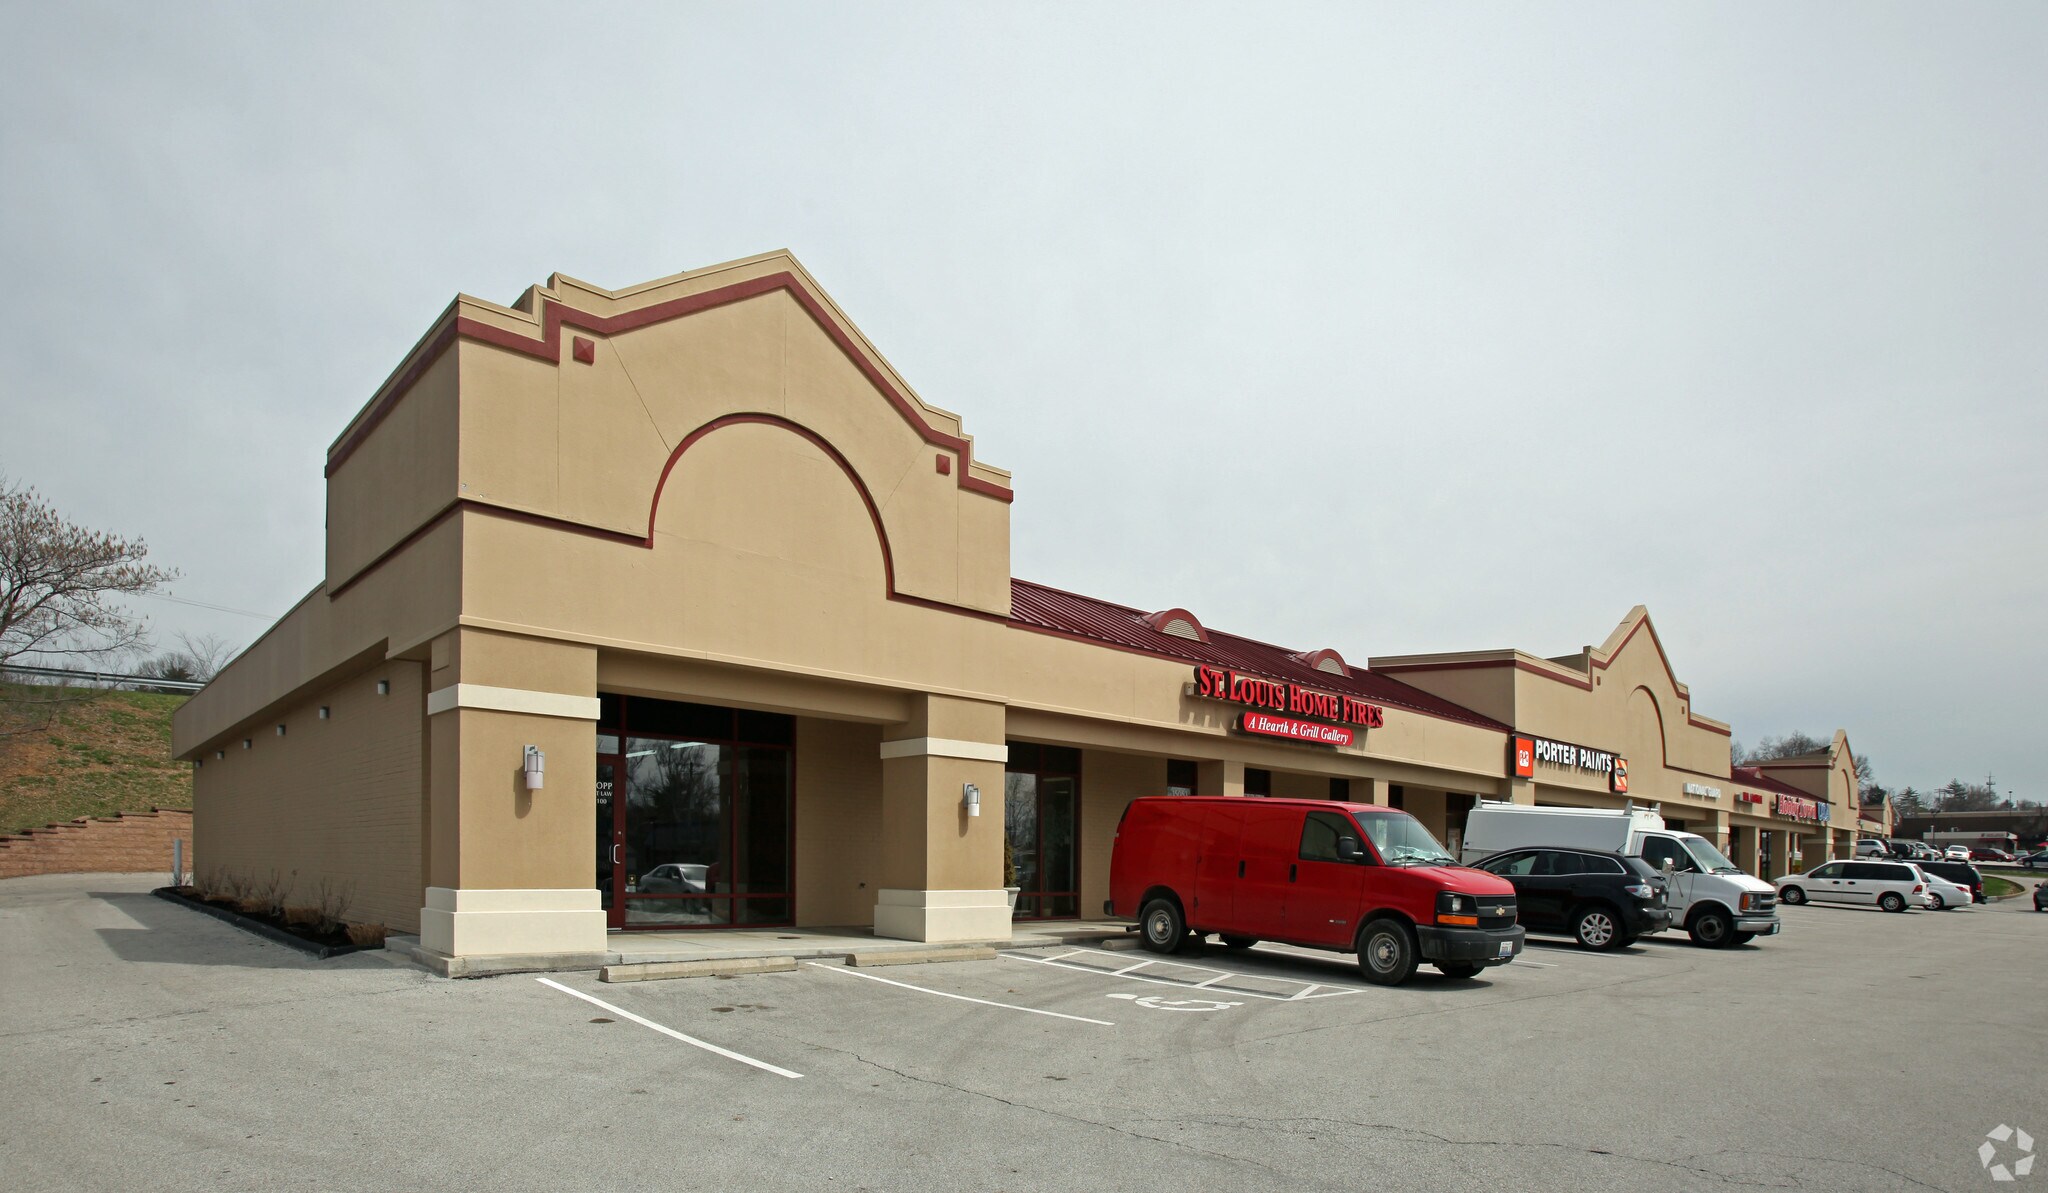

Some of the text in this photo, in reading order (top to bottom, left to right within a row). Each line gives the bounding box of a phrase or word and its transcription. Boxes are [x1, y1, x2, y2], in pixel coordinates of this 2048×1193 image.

[1199, 664, 1384, 729] ST. LOUIS HOME FIRES
[1248, 716, 1349, 745] A Hearth & Grill Gallery
[1535, 739, 1577, 766] PORTER
[1580, 748, 1612, 773] PAINTS
